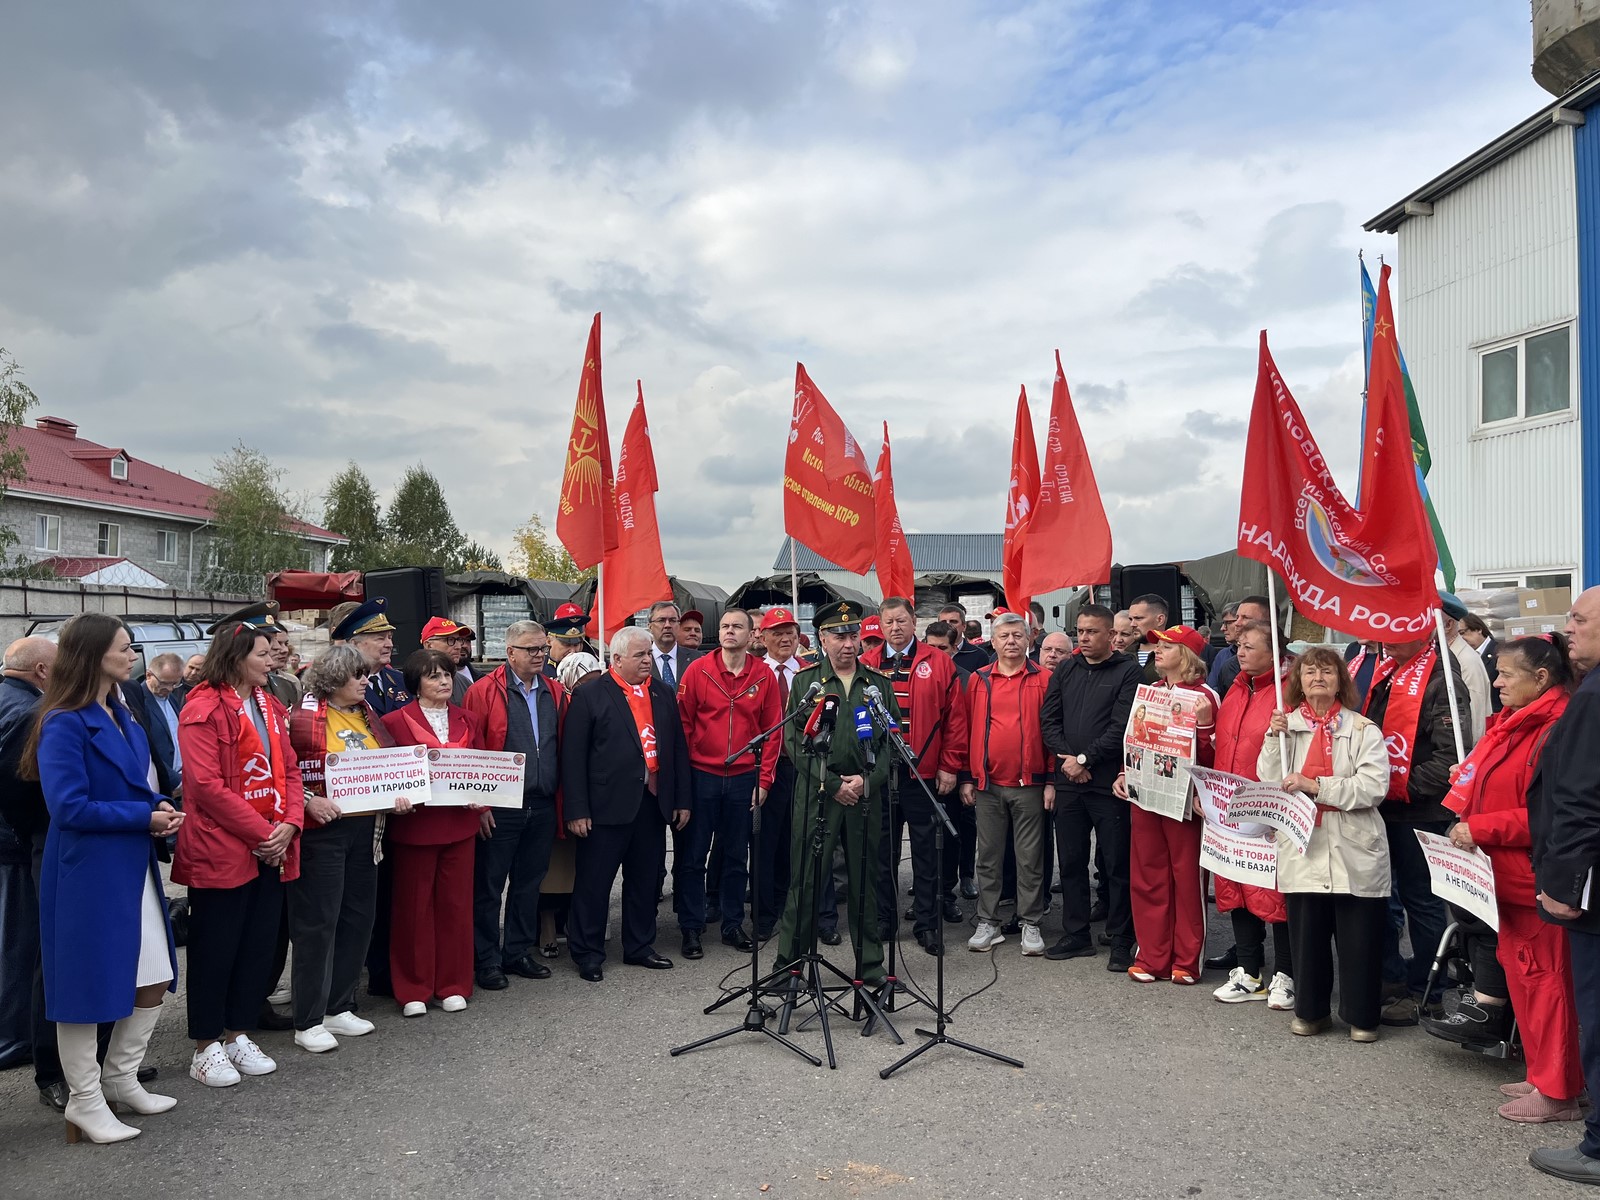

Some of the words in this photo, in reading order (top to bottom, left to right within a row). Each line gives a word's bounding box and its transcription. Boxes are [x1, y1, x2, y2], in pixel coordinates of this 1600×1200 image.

[1054, 464, 1073, 504] ОРДЕНА
[834, 504, 860, 527] КПРФ
[1239, 521, 1340, 616] НАДЕЖДА
[1408, 658, 1428, 696] ПАРТИЯ
[299, 759, 321, 769] ДЕТИ
[360, 754, 390, 762] ПРОГРАММУ
[332, 772, 383, 786] ОСТАНОВИМ
[384, 770, 405, 780] РОСТ
[407, 768, 426, 779] ЦЕН,
[332, 786, 371, 799] ДОЛГОВ
[372, 785, 379, 793] И
[381, 779, 426, 792] ТАРИФОВ
[449, 782, 498, 792] НАРОДУ
[481, 772, 519, 782] РОССИИ
[1228, 810, 1260, 818] РАБОЧИЕ
[1261, 810, 1284, 825] МЕСТА
[1285, 818, 1290, 826] И
[1231, 801, 1279, 810] ГОРОДАМ
[1280, 805, 1287, 813] И
[1289, 810, 1309, 834] СЕЛАМ
[1202, 844, 1230, 864] МЕДИЦИНА
[1235, 859, 1246, 869] НЕ
[1247, 862, 1276, 873] БАЗАР
[1203, 834, 1228, 853] ЗДОРОВЬЕ
[1233, 848, 1243, 857] НЕ
[1245, 850, 1276, 863] ТОВАР,
[1428, 855, 1477, 883] СПРАВЕДЛИВЫЕ
[1446, 873, 1451, 883] А
[1451, 875, 1460, 888] НЕ
[1461, 880, 1489, 903] ПОДАЧКИ
